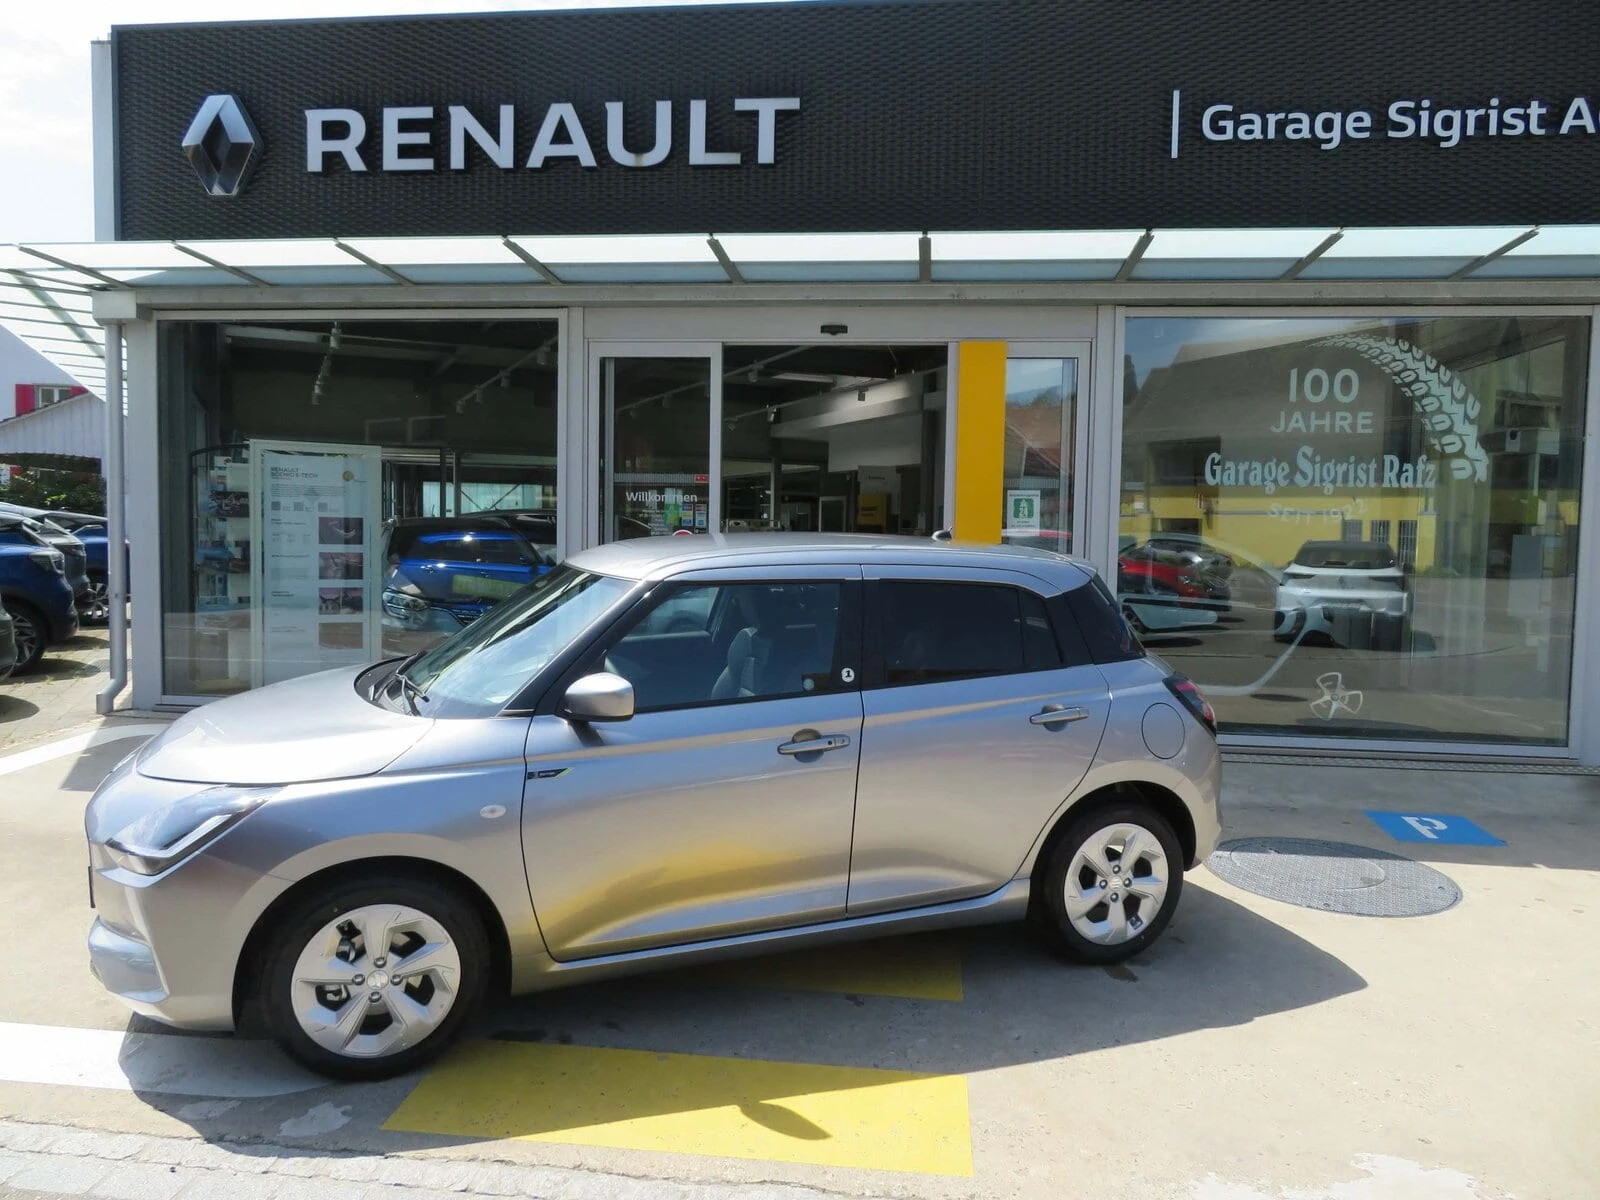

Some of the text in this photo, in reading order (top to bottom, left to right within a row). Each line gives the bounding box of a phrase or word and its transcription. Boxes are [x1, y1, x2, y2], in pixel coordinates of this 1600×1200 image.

[305, 97, 800, 173] RENAULT
[1201, 97, 1600, 150] Garage Sigrist A
[1288, 368, 1360, 403] 100
[1270, 411, 1374, 434] JAHRE
[1204, 445, 1436, 495] Garage Sigrist Rafz
